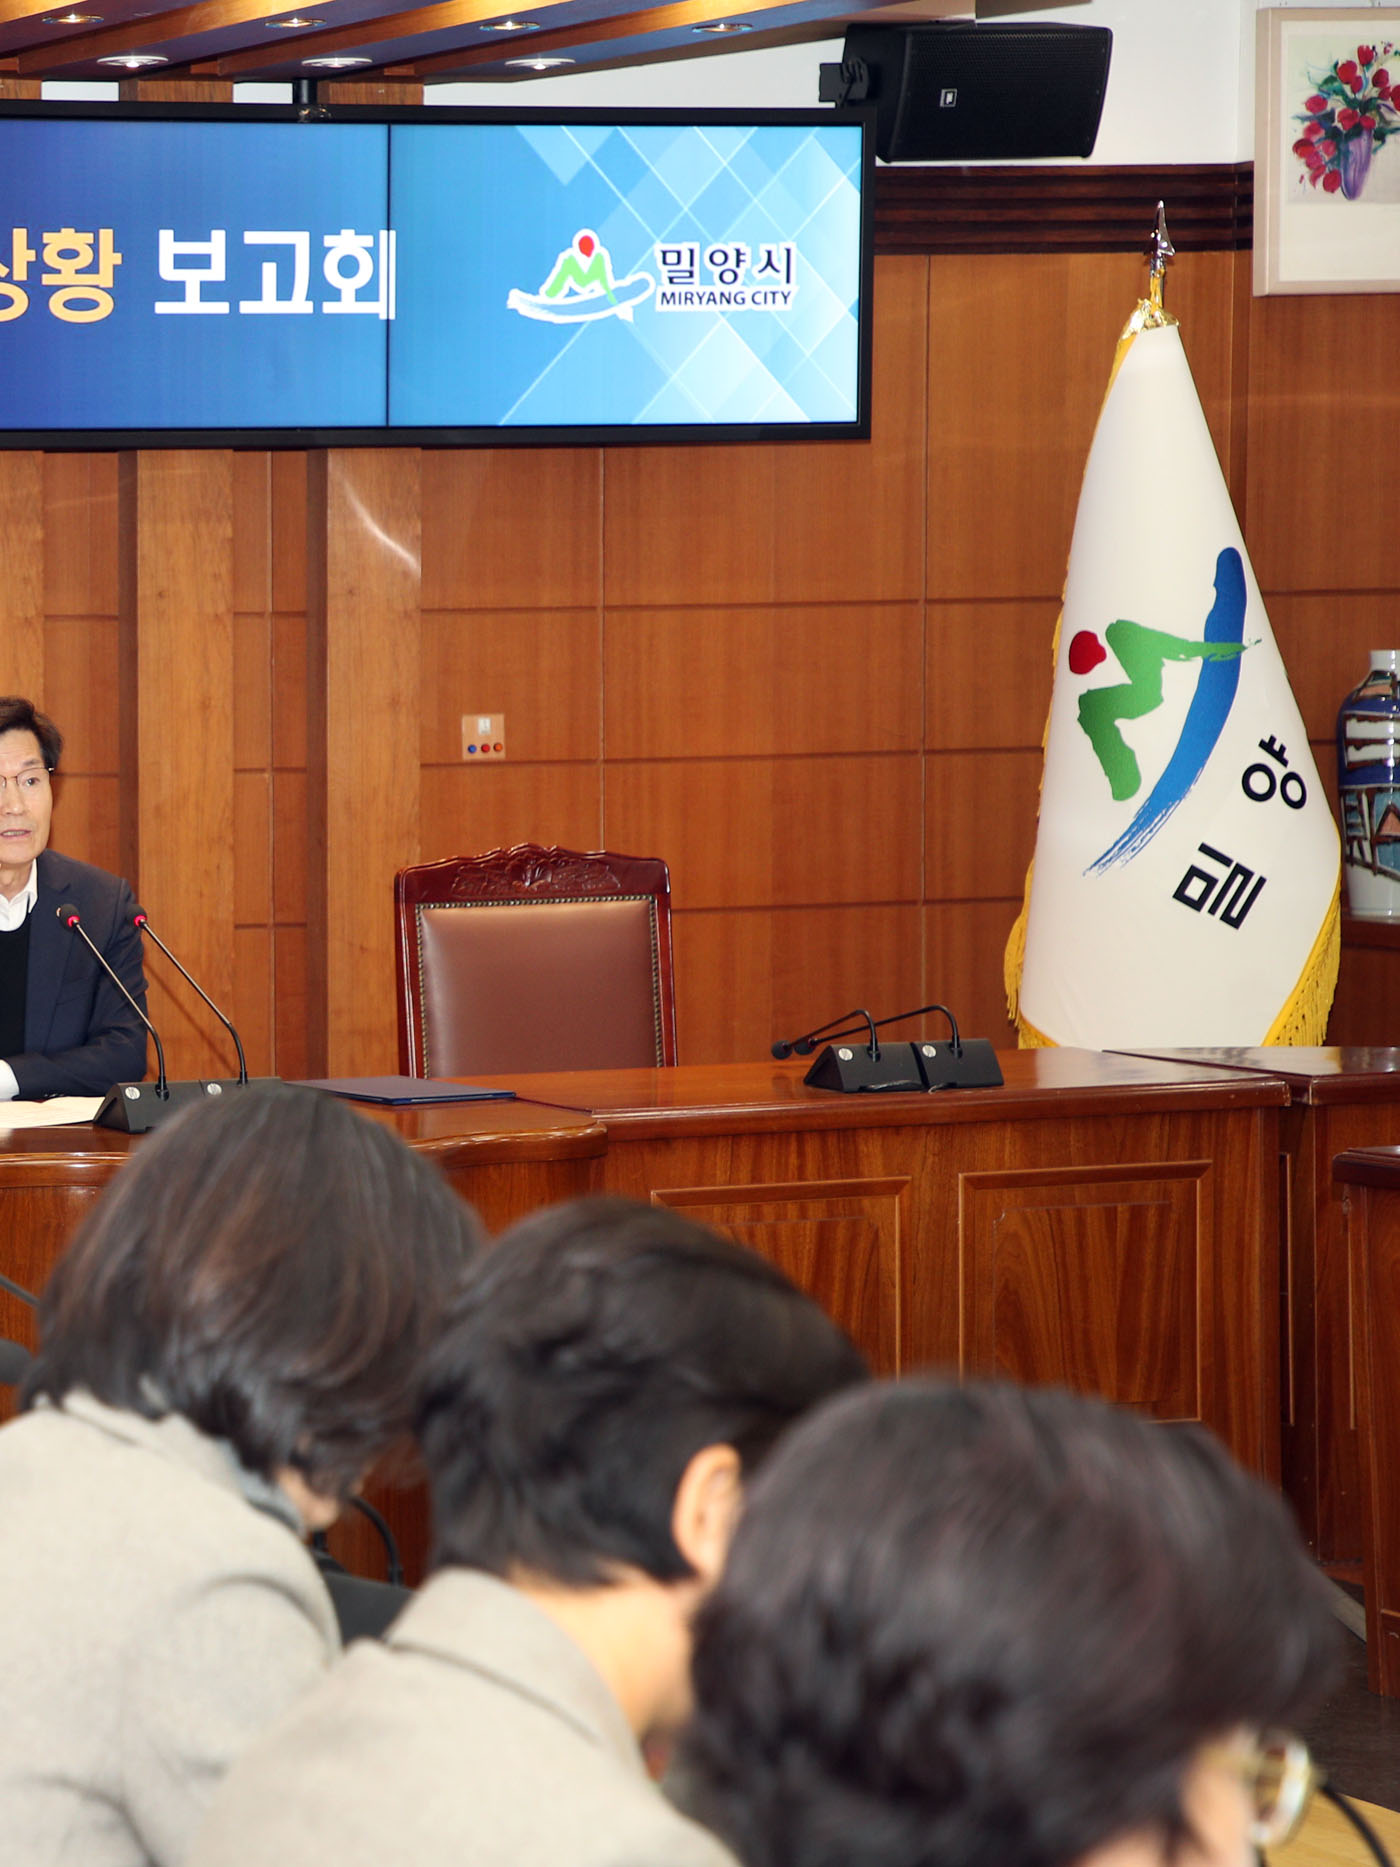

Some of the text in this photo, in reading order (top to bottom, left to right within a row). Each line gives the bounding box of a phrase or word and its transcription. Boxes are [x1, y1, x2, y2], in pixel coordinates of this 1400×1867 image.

[154, 228, 397, 321] 보고회
[661, 247, 792, 285] 밀양시
[660, 290, 792, 306] MIRYANG CITY
